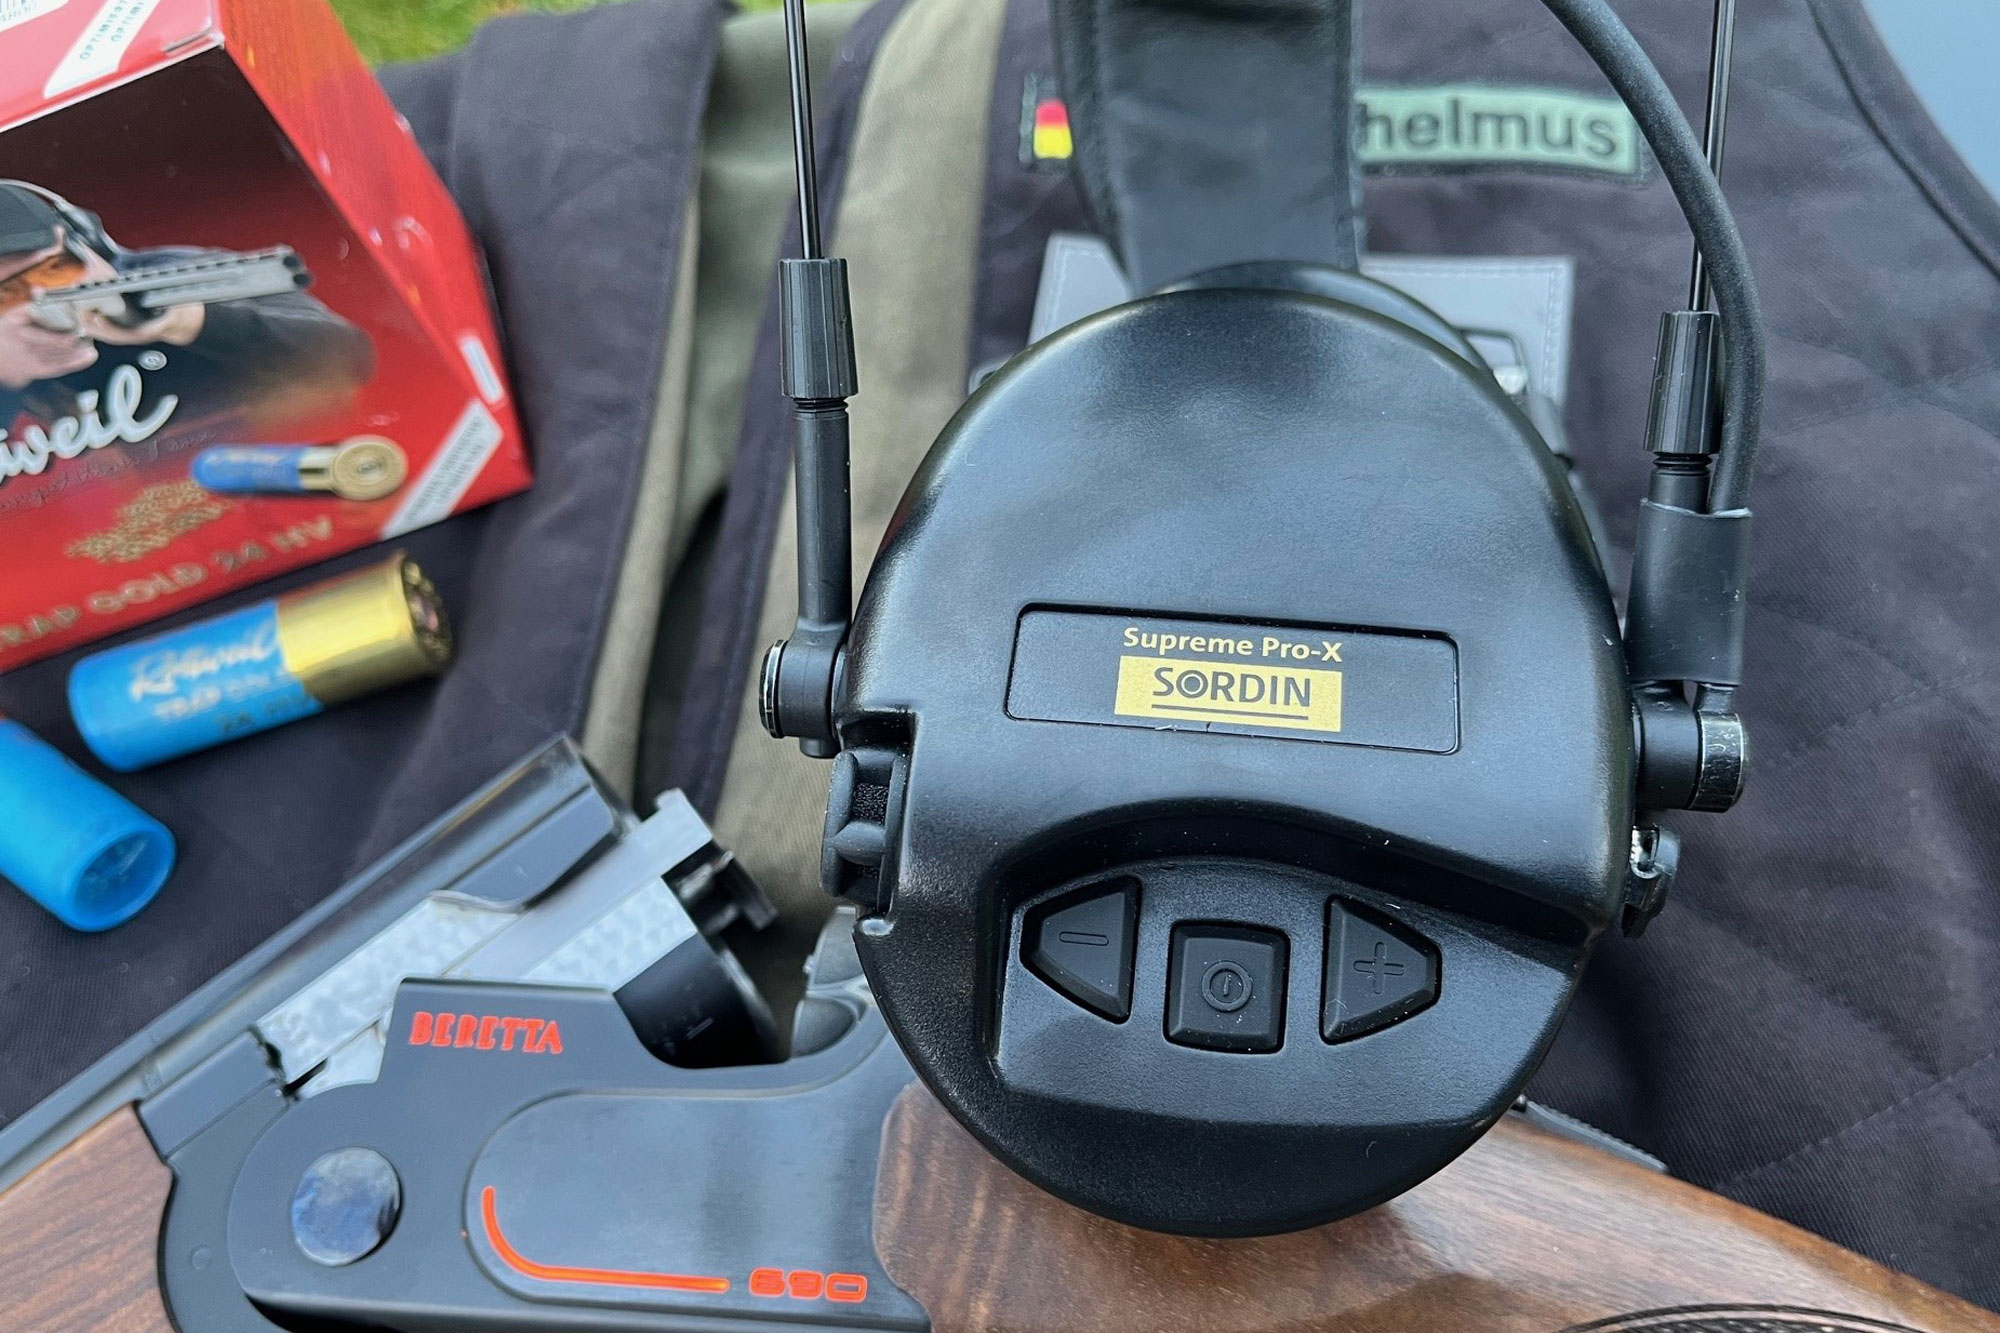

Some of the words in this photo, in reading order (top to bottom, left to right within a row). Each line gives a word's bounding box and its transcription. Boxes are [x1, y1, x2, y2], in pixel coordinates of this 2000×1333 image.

[0, 364, 179, 484] weil
[1122, 627, 1254, 656] Supreme
[1261, 636, 1343, 663] Pro-X
[1152, 666, 1311, 707] SORDIN
[409, 1010, 564, 1055] BERETTA
[749, 1266, 869, 1303] 690
